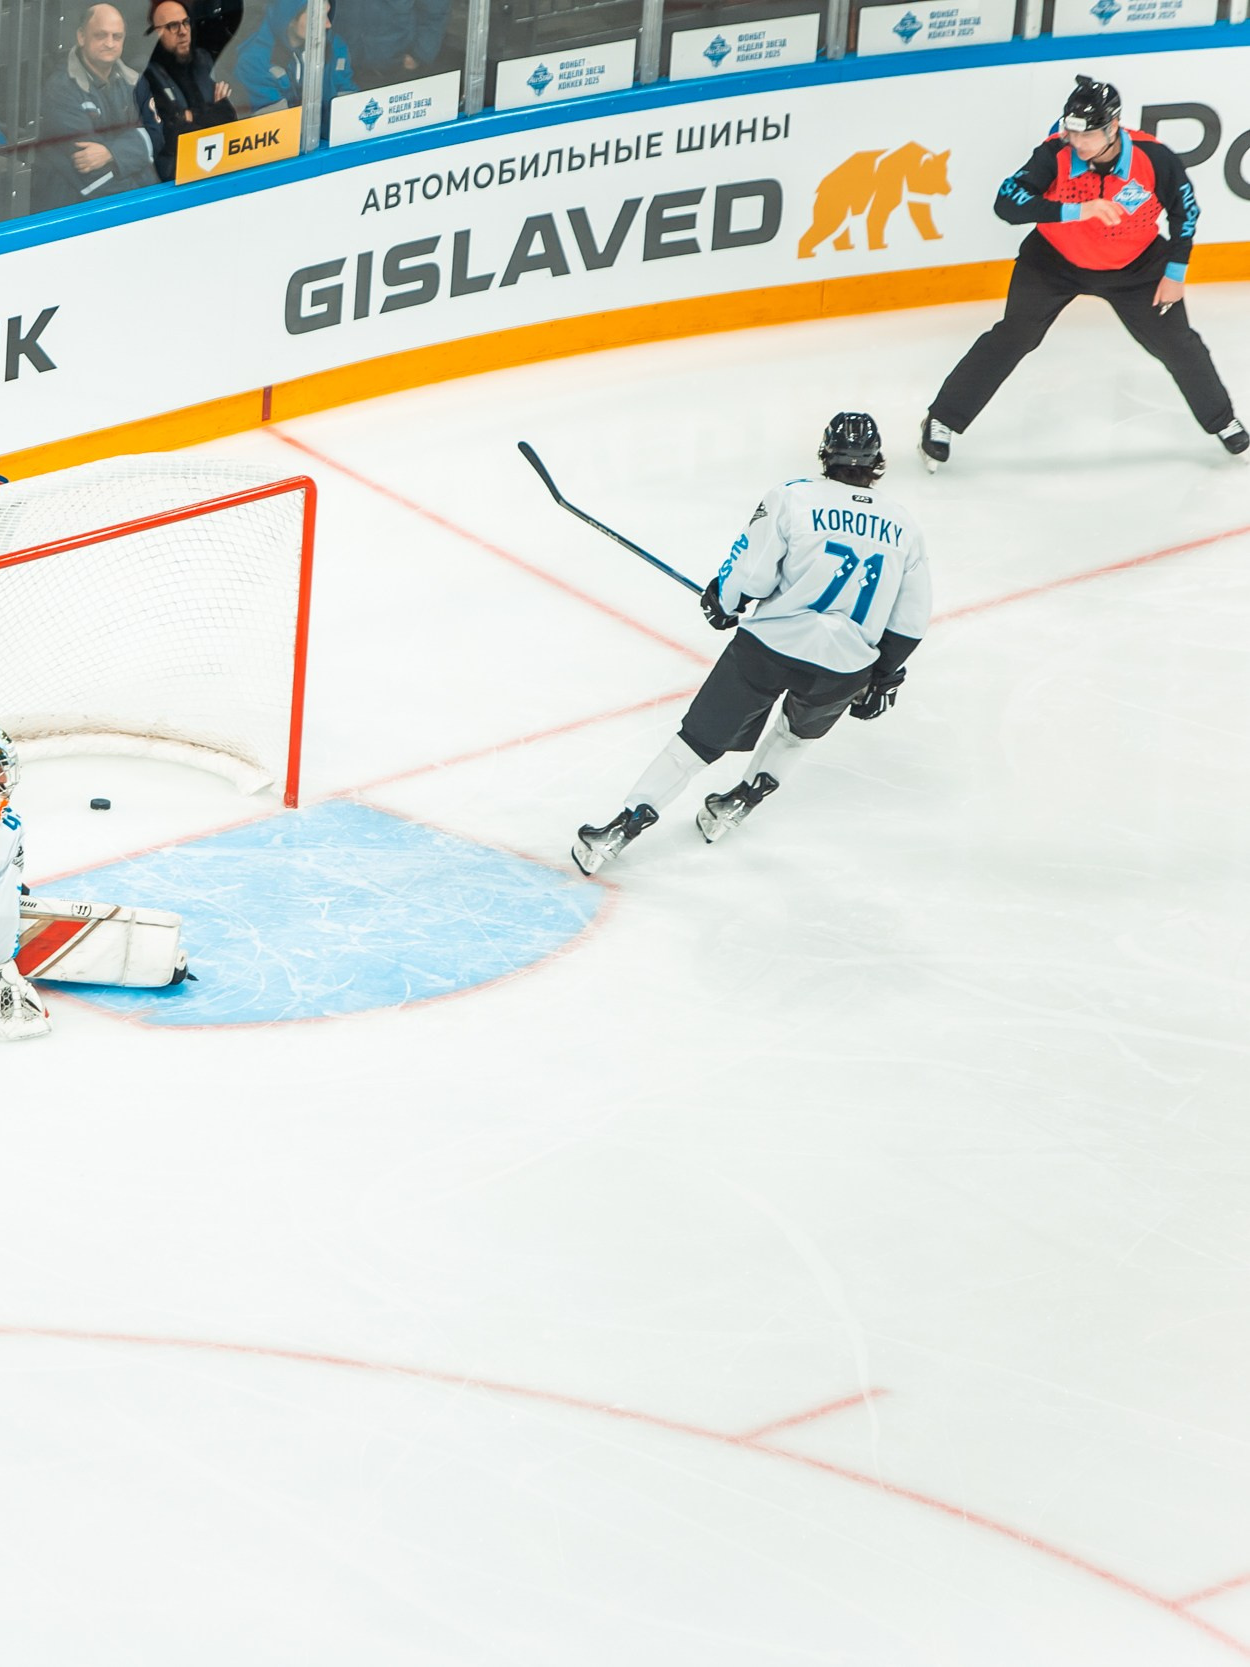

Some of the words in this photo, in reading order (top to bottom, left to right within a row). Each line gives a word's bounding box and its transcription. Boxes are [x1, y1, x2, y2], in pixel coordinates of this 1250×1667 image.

[558, 68, 583, 80] НЕДЕЛЯ
[585, 65, 606, 74] ЗВЕЗД
[559, 58, 586, 70] ФОНБЕТ
[558, 78, 582, 90] ХОККЕЯ
[584, 76, 600, 86] 2025
[388, 91, 414, 104] ФОНБЕТ
[388, 102, 412, 114] НЕДЕЛЯ
[413, 97, 432, 107] ЗВЕЗД
[387, 112, 411, 125] ХОККЕЯ
[412, 108, 427, 119] 2025
[228, 128, 280, 156] БАНК
[360, 131, 664, 216] АВТОМОБИЛЬНЫЕ
[676, 113, 791, 153] ШИНЫ
[284, 177, 784, 335] GISLAVED
[811, 508, 903, 548] KOROTKY
[807, 539, 885, 626] 71
